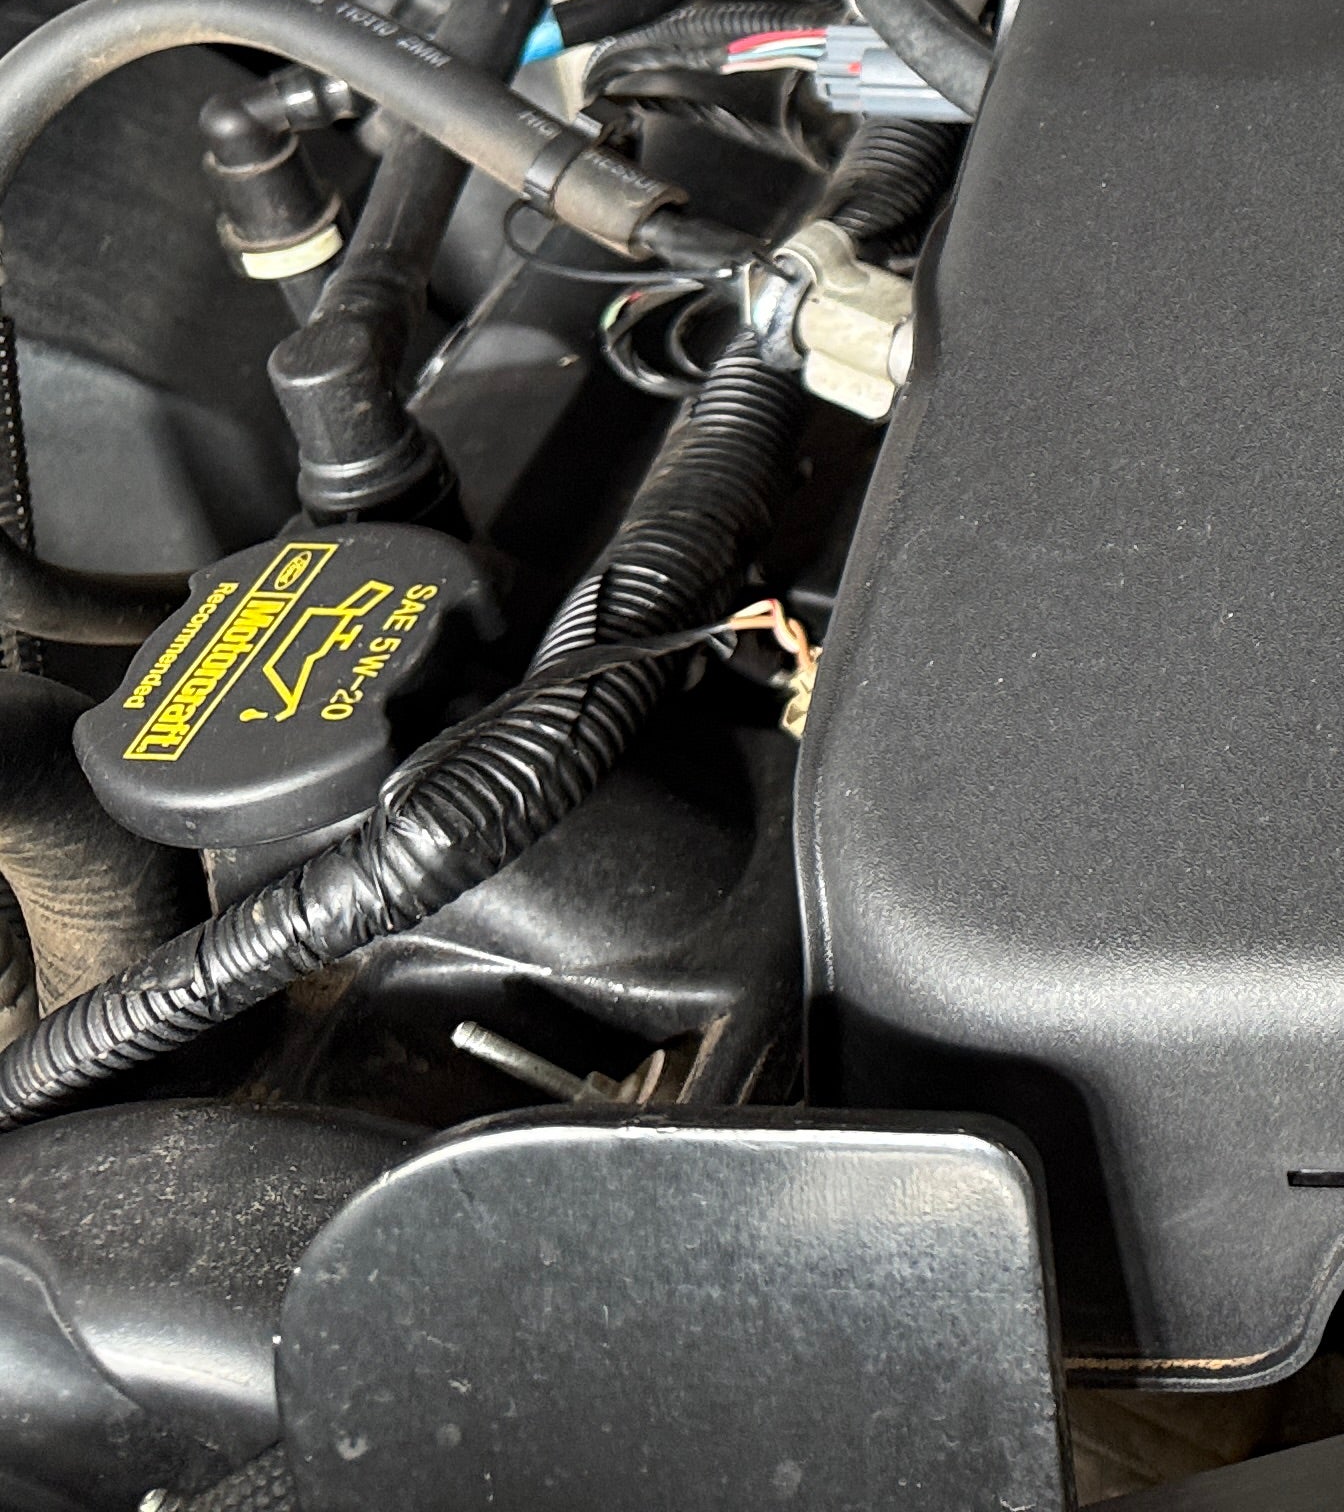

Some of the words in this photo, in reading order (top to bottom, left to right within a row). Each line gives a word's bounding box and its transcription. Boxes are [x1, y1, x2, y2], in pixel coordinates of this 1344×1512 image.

[122, 582, 240, 709] Recommended
[382, 583, 438, 631] SAE
[135, 599, 286, 753] Motorcraft
[320, 636, 402, 720] 5W-20
